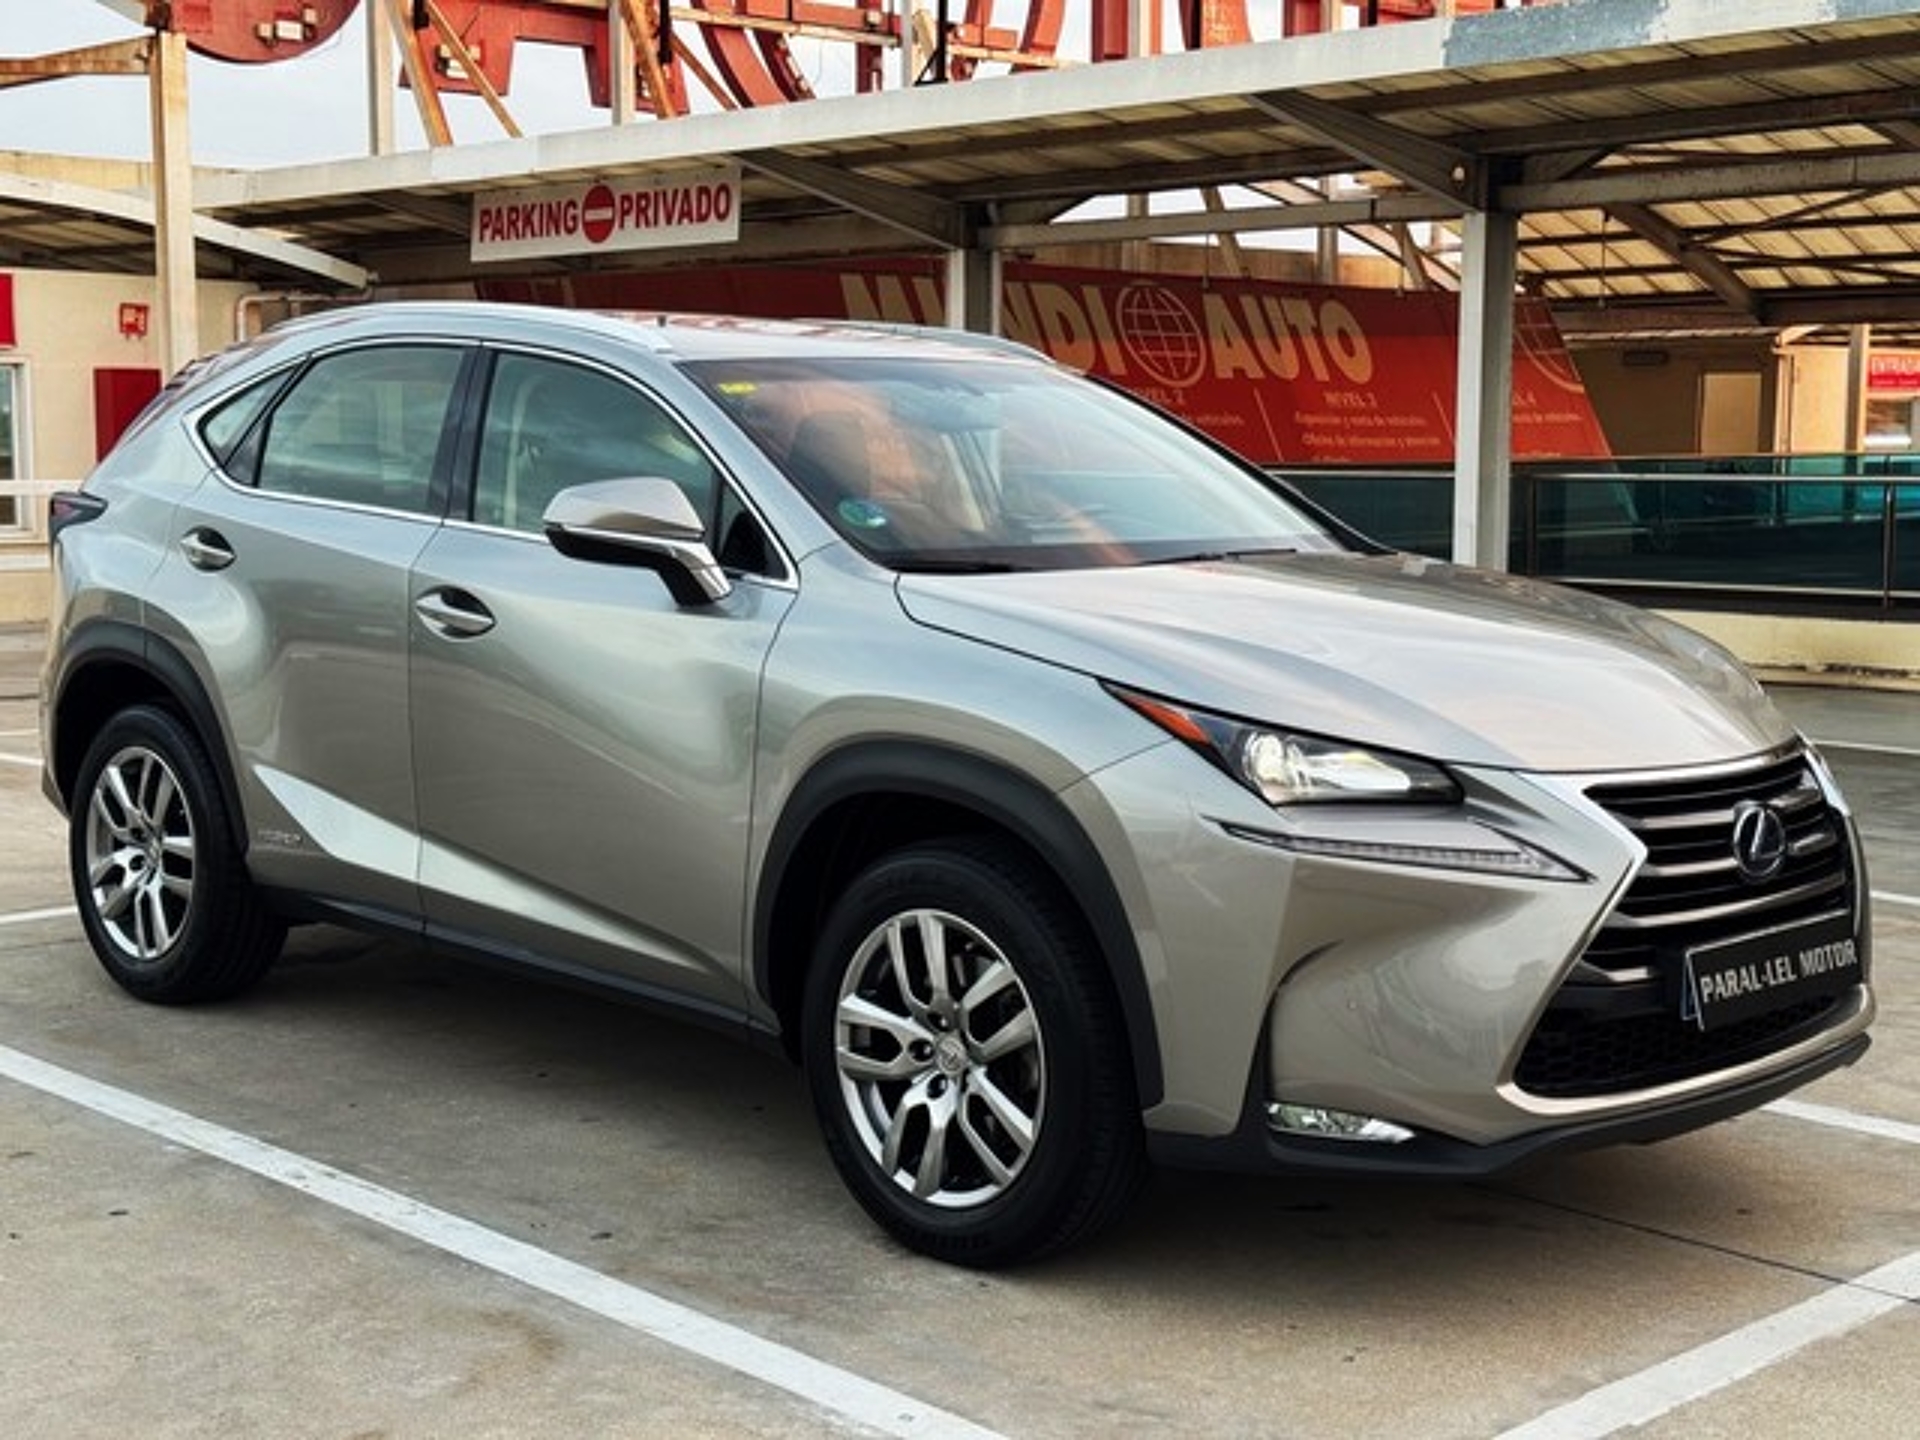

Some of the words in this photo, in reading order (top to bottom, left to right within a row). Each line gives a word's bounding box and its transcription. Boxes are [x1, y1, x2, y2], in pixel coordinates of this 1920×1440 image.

[479, 200, 578, 243] PARKING
[619, 183, 731, 230] PRIVADO
[1202, 294, 1373, 383] AUTO
[1799, 939, 1857, 977] MOTOR
